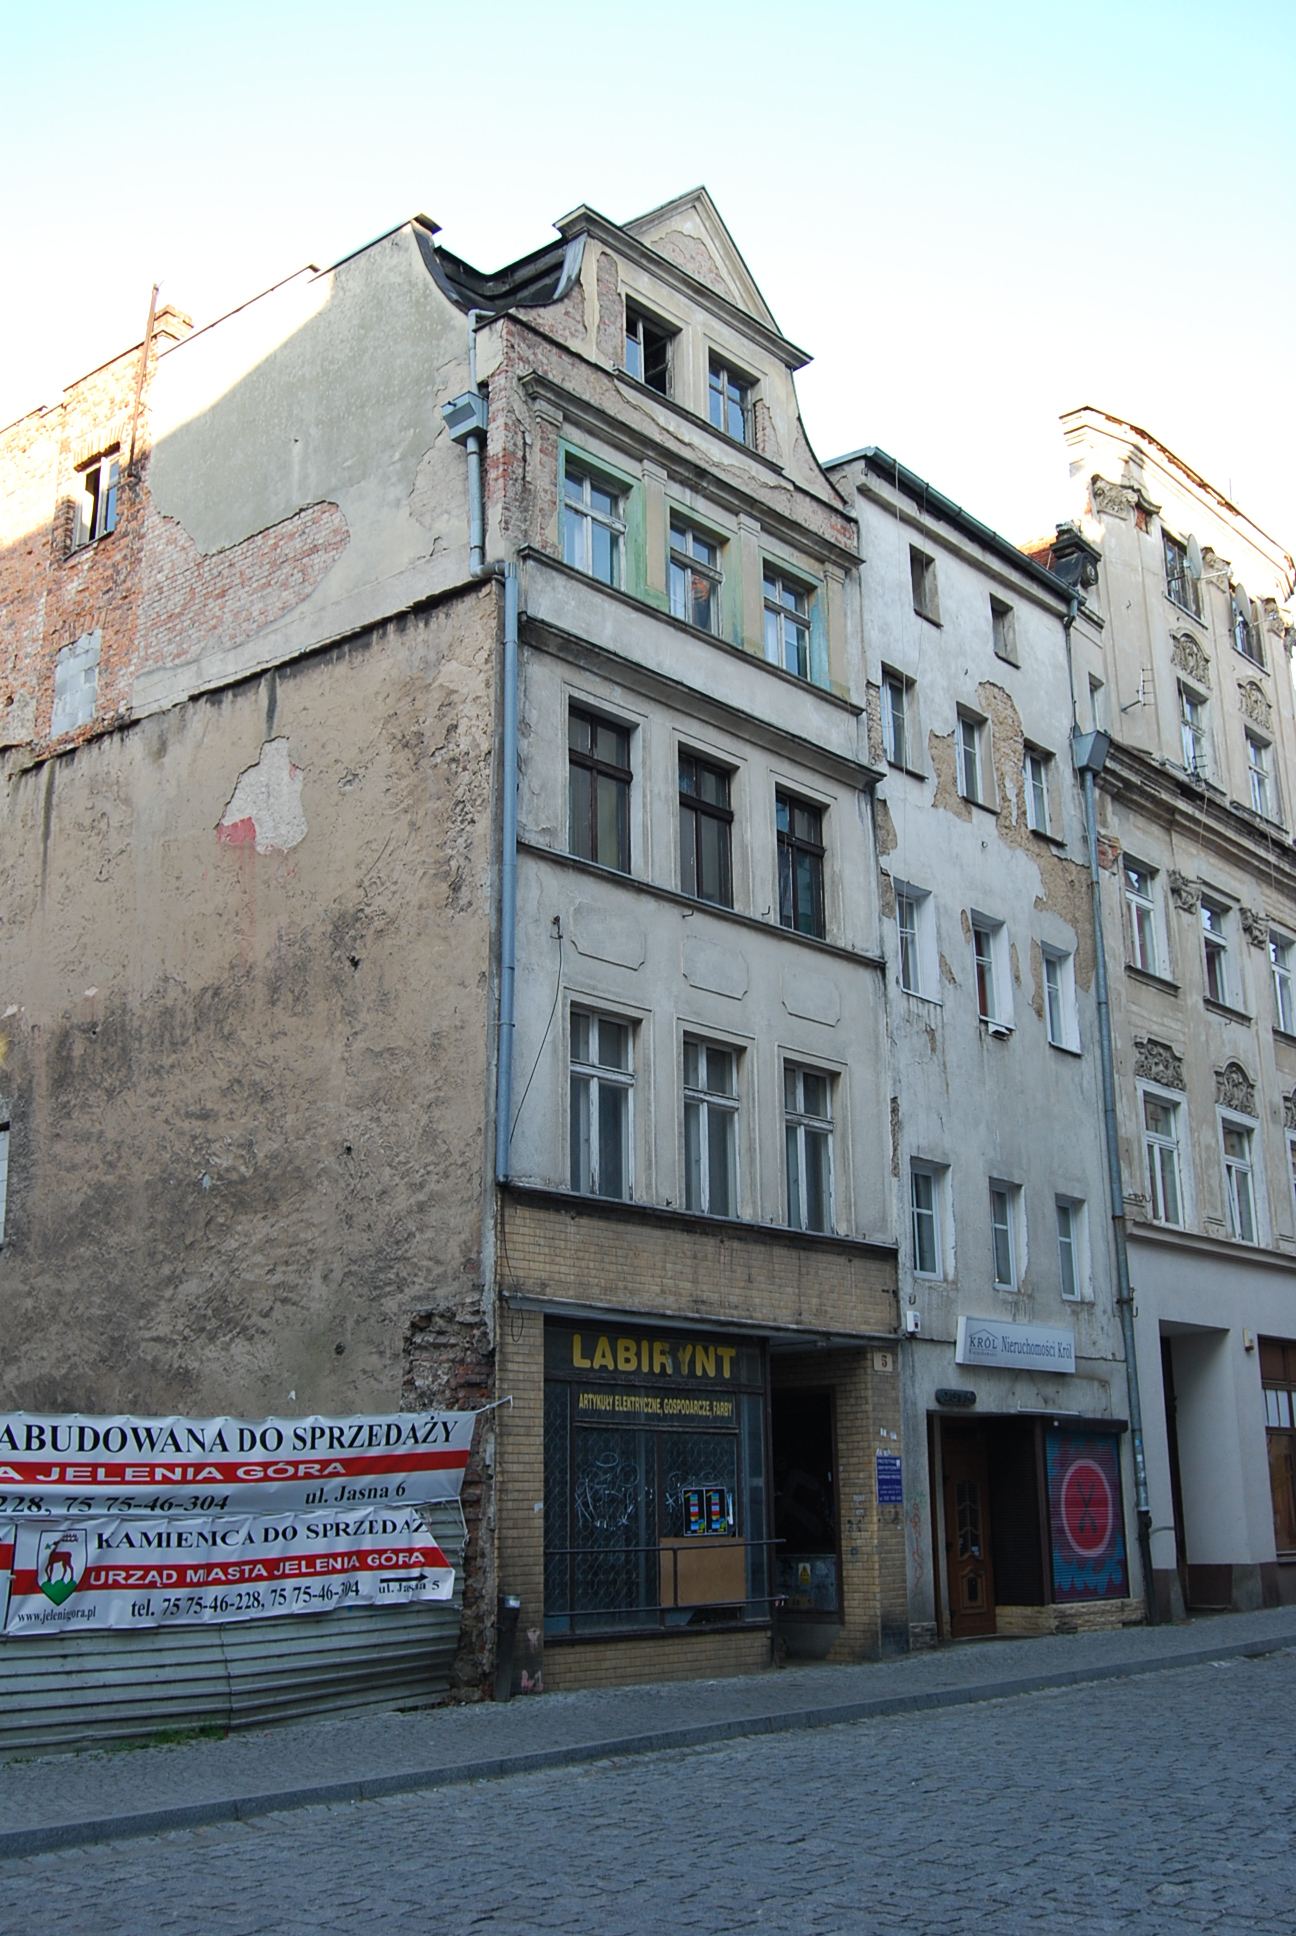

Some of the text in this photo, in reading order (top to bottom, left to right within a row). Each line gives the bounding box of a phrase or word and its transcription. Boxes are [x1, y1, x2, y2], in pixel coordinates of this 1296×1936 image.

[572, 1333, 736, 1379] LABIRYNT
[1001, 1335, 1056, 1358] Nieruchomości
[1057, 1342, 1072, 1359] Król
[881, 1354, 888, 1368] 5
[615, 1395, 663, 1416] ELEKTRYCZNE,
[663, 1398, 712, 1419] GOSPODARCZE,
[713, 1401, 732, 1417] FARBY
[237, 1427, 284, 1453] DO
[292, 1416, 458, 1451] SPRZEDAŻY
[36, 1467, 224, 1481] JELENIA
[236, 1462, 346, 1480] GÓRA
[63, 1496, 95, 1513] 75
[104, 1494, 230, 1513] 75-46-304
[305, 1480, 406, 1504] ul. Jasna 6
[263, 1525, 298, 1544] DO
[90, 1570, 177, 1587] URZĄD
[274, 1556, 360, 1576] JELENIA
[367, 1550, 425, 1566] GÓRA
[379, 1583, 394, 1594] ul.
[431, 1580, 440, 1591] 5
[17, 1605, 96, 1624] www.jelenigora.pl
[131, 1597, 155, 1617] tel.
[162, 1597, 182, 1616] 75
[185, 1588, 265, 1613] 75-46-228,
[270, 1588, 287, 1607] 75
